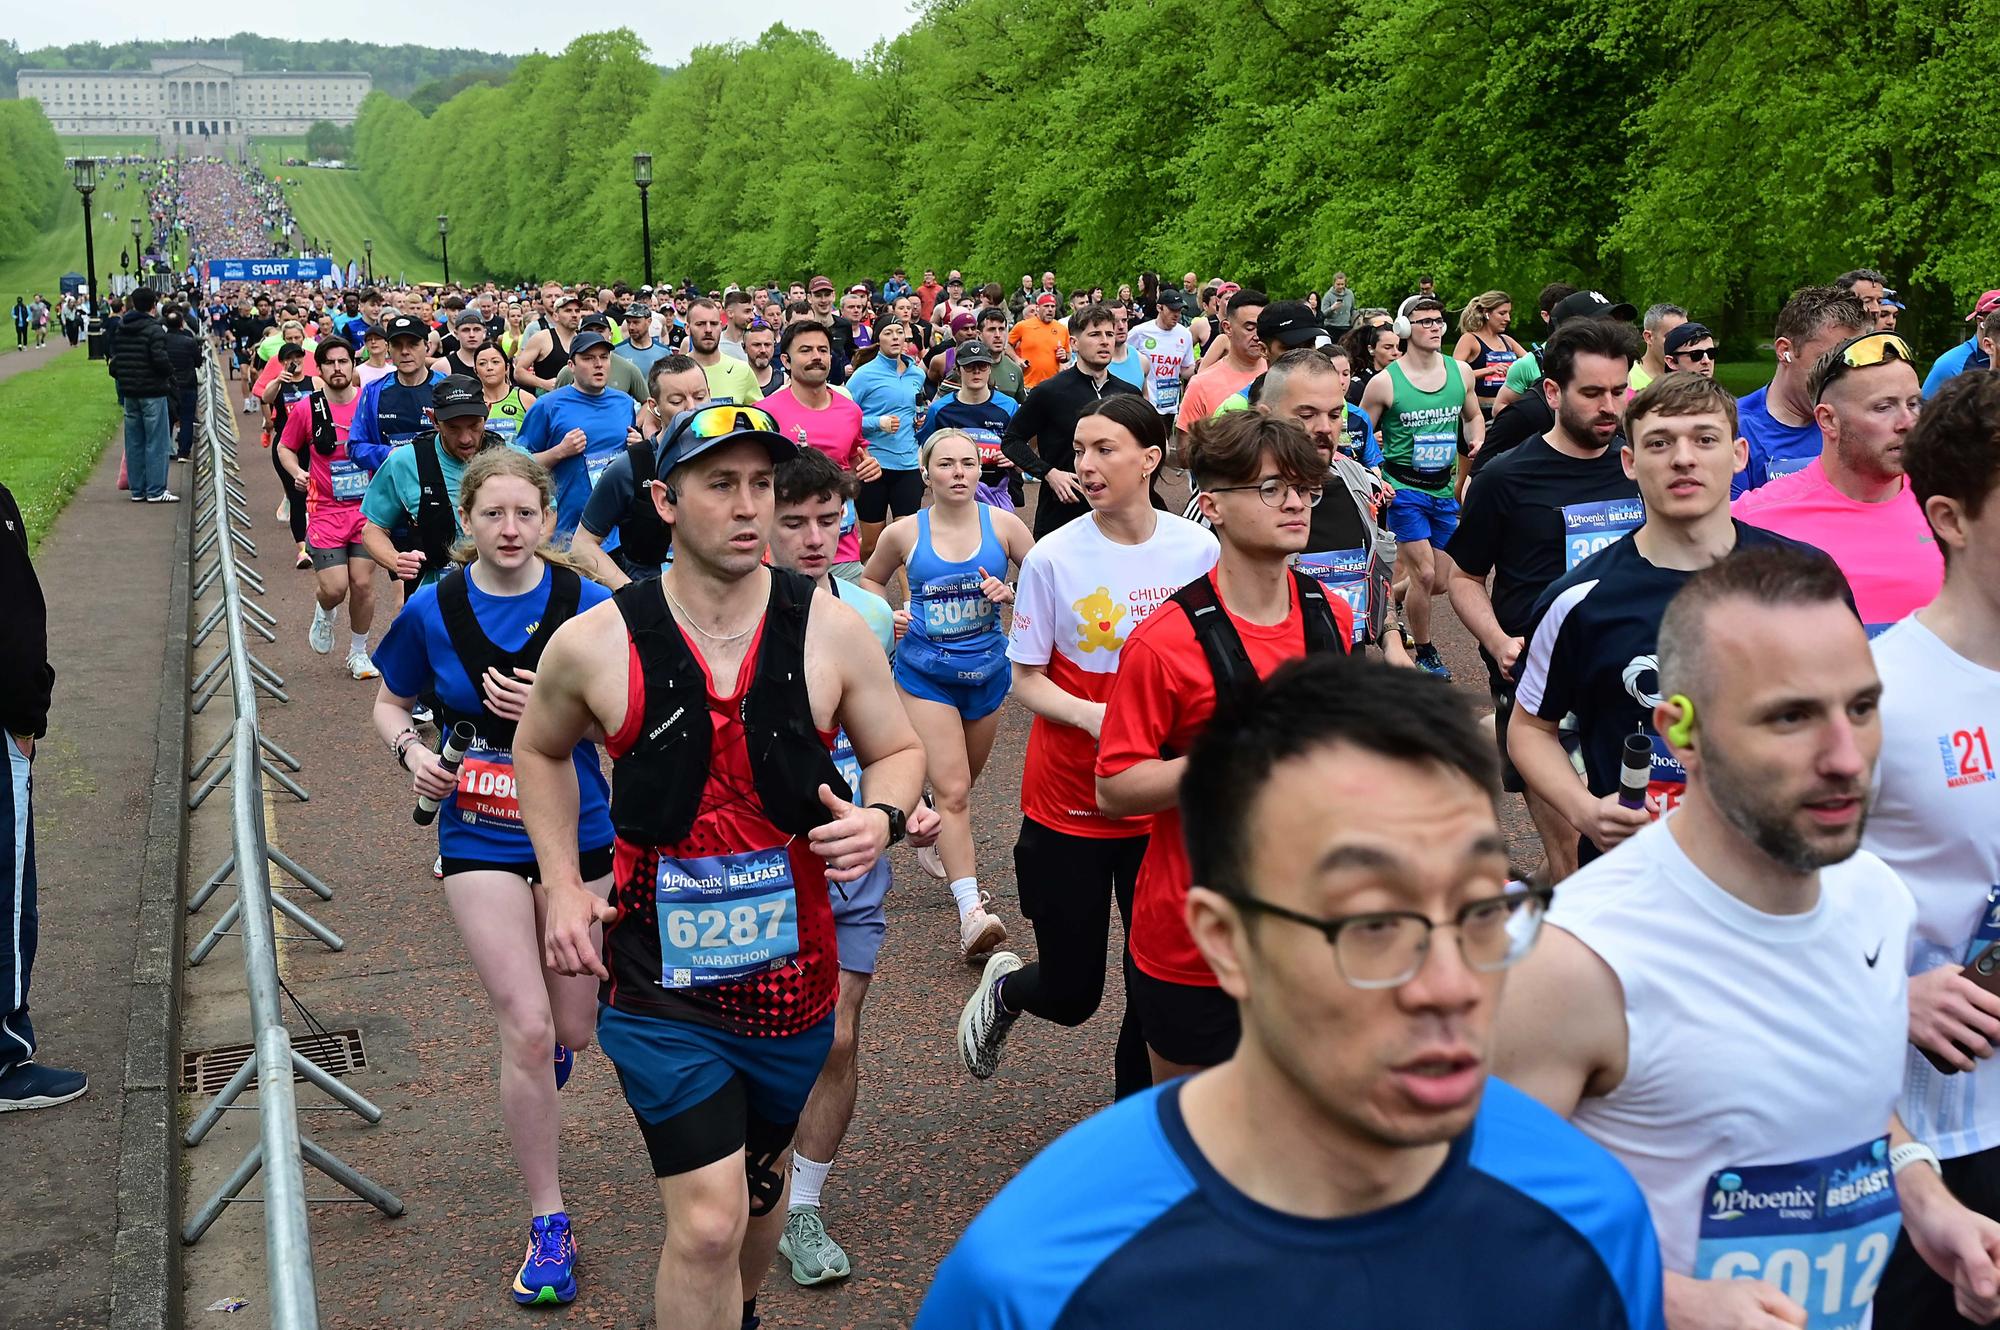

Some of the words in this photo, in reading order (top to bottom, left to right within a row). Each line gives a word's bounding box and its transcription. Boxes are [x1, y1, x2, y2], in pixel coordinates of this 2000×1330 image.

[252, 264, 289, 275] START
[1150, 354, 1181, 365] TEAM
[1403, 419, 1430, 428] CANCER
[1415, 446, 1452, 461] 2421
[335, 473, 369, 490] 2738
[1573, 512, 1605, 524] Phoenix
[1609, 511, 1642, 521] BELFAST
[930, 583, 959, 593] Phoenix
[961, 582, 981, 590] BELF
[928, 596, 992, 626] 3046
[942, 622, 982, 635] MARATHON
[649, 706, 685, 740] SALOMON
[1953, 726, 1993, 775] 21
[476, 802, 505, 817] TEAM
[671, 875, 723, 889] Phoenix
[729, 864, 786, 887] BELFAST
[667, 898, 787, 949] 6287
[692, 948, 770, 966] MARATHON
[1727, 1185, 1816, 1211] Phoenix
[1826, 1168, 1890, 1208] BELFAST
